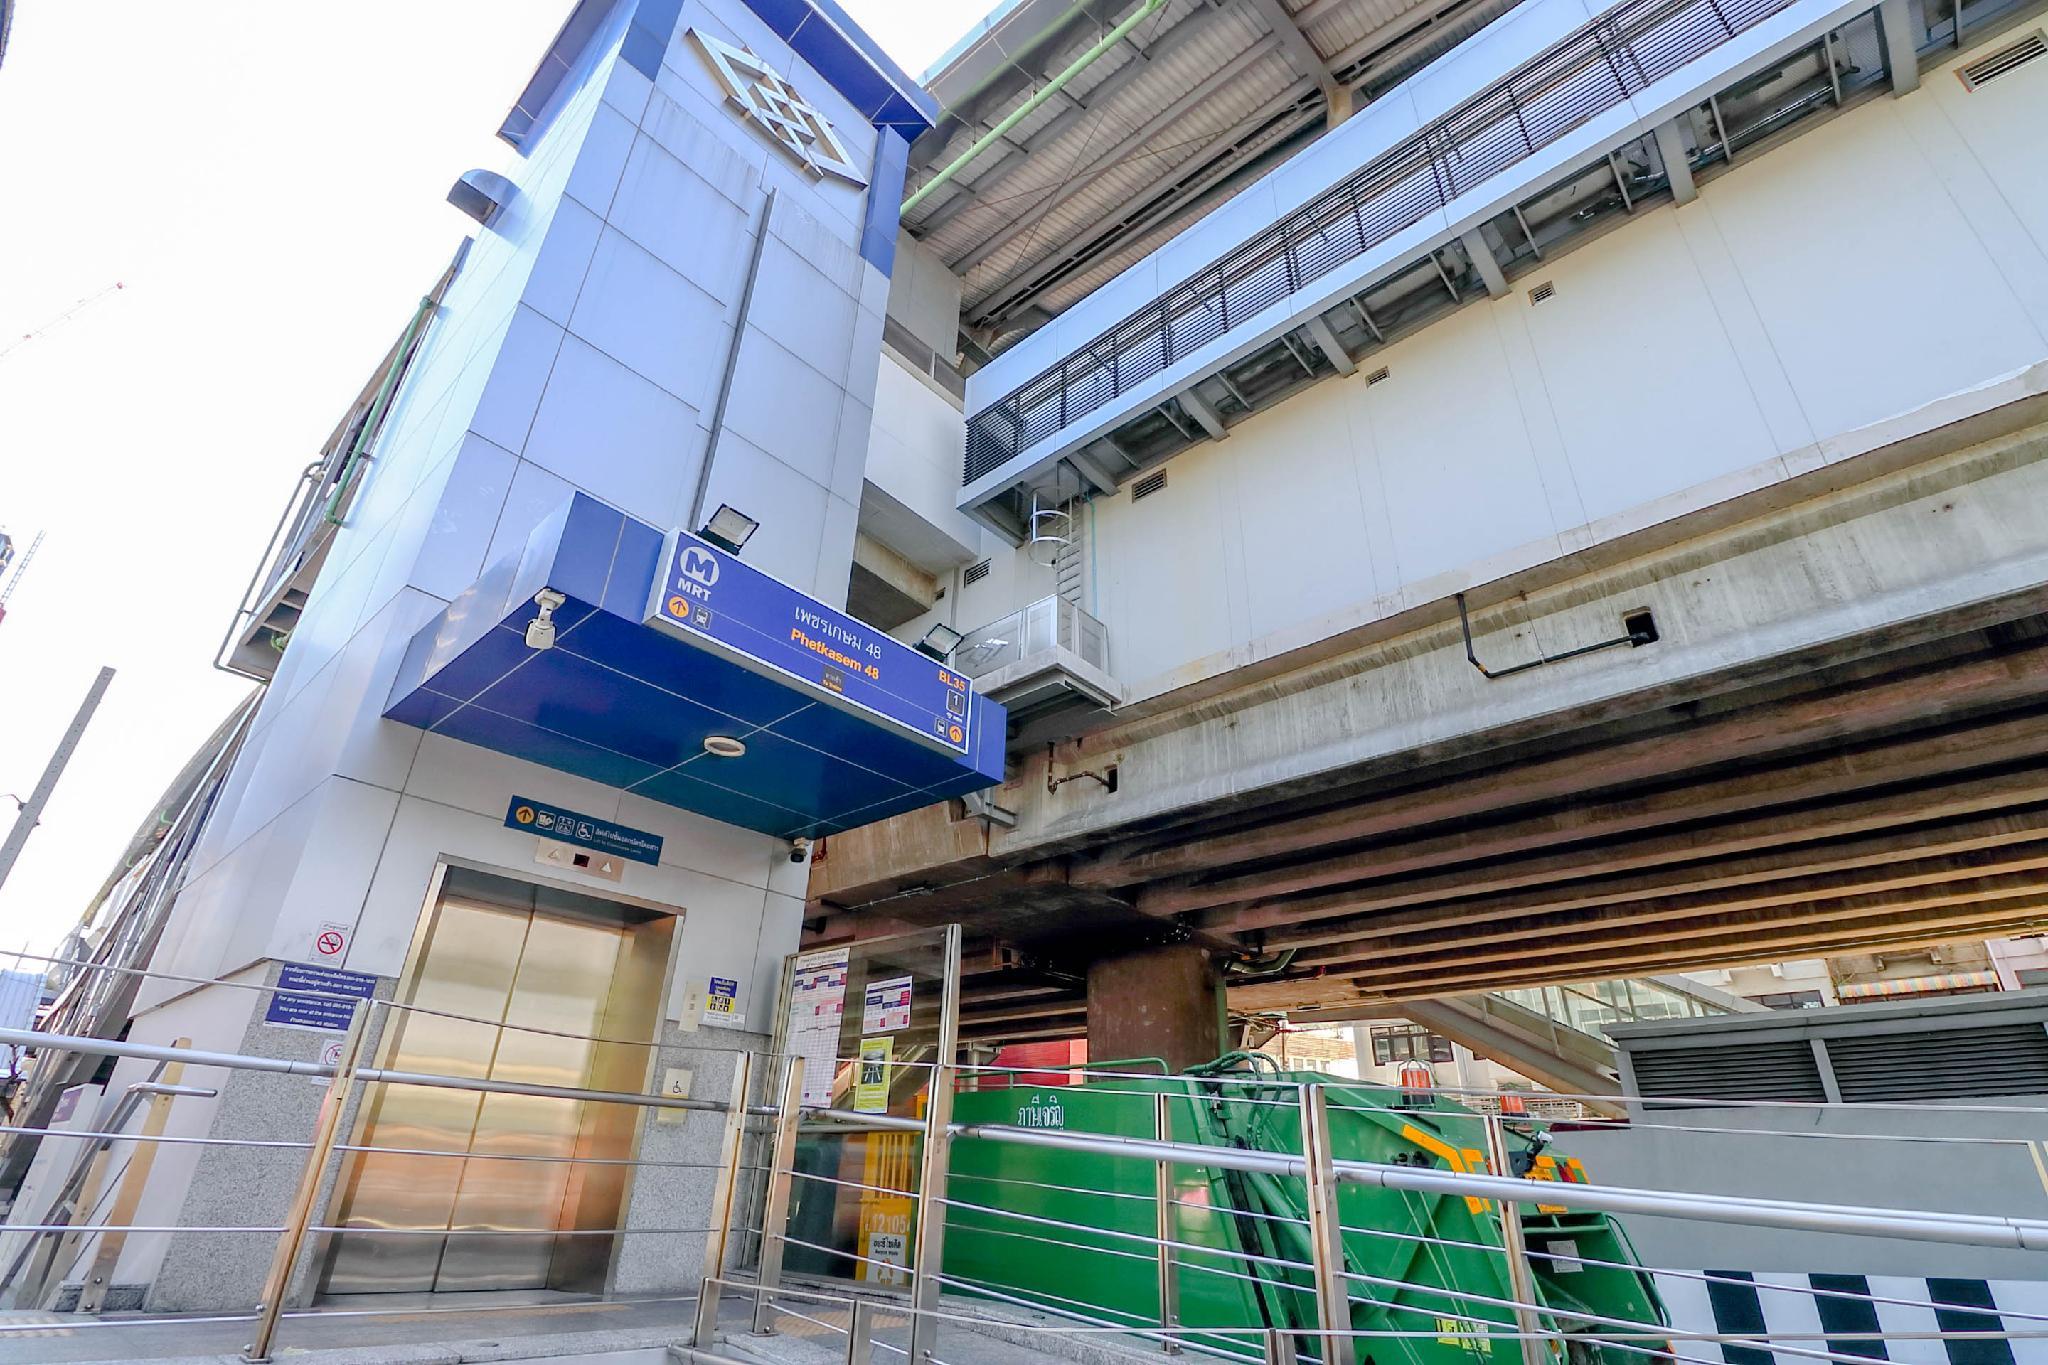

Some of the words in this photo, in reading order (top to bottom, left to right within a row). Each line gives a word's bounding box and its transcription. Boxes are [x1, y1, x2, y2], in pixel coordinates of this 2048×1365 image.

[677, 577, 712, 602] MRT
[795, 606, 862, 650] เพชรเกษม
[865, 642, 882, 660] 48
[790, 627, 862, 673] Phetkasem
[864, 664, 880, 681] 48
[938, 669, 966, 692] BL35
[952, 694, 959, 706] 1
[1018, 1093, 1064, 1130] ภาษีเจริญ
